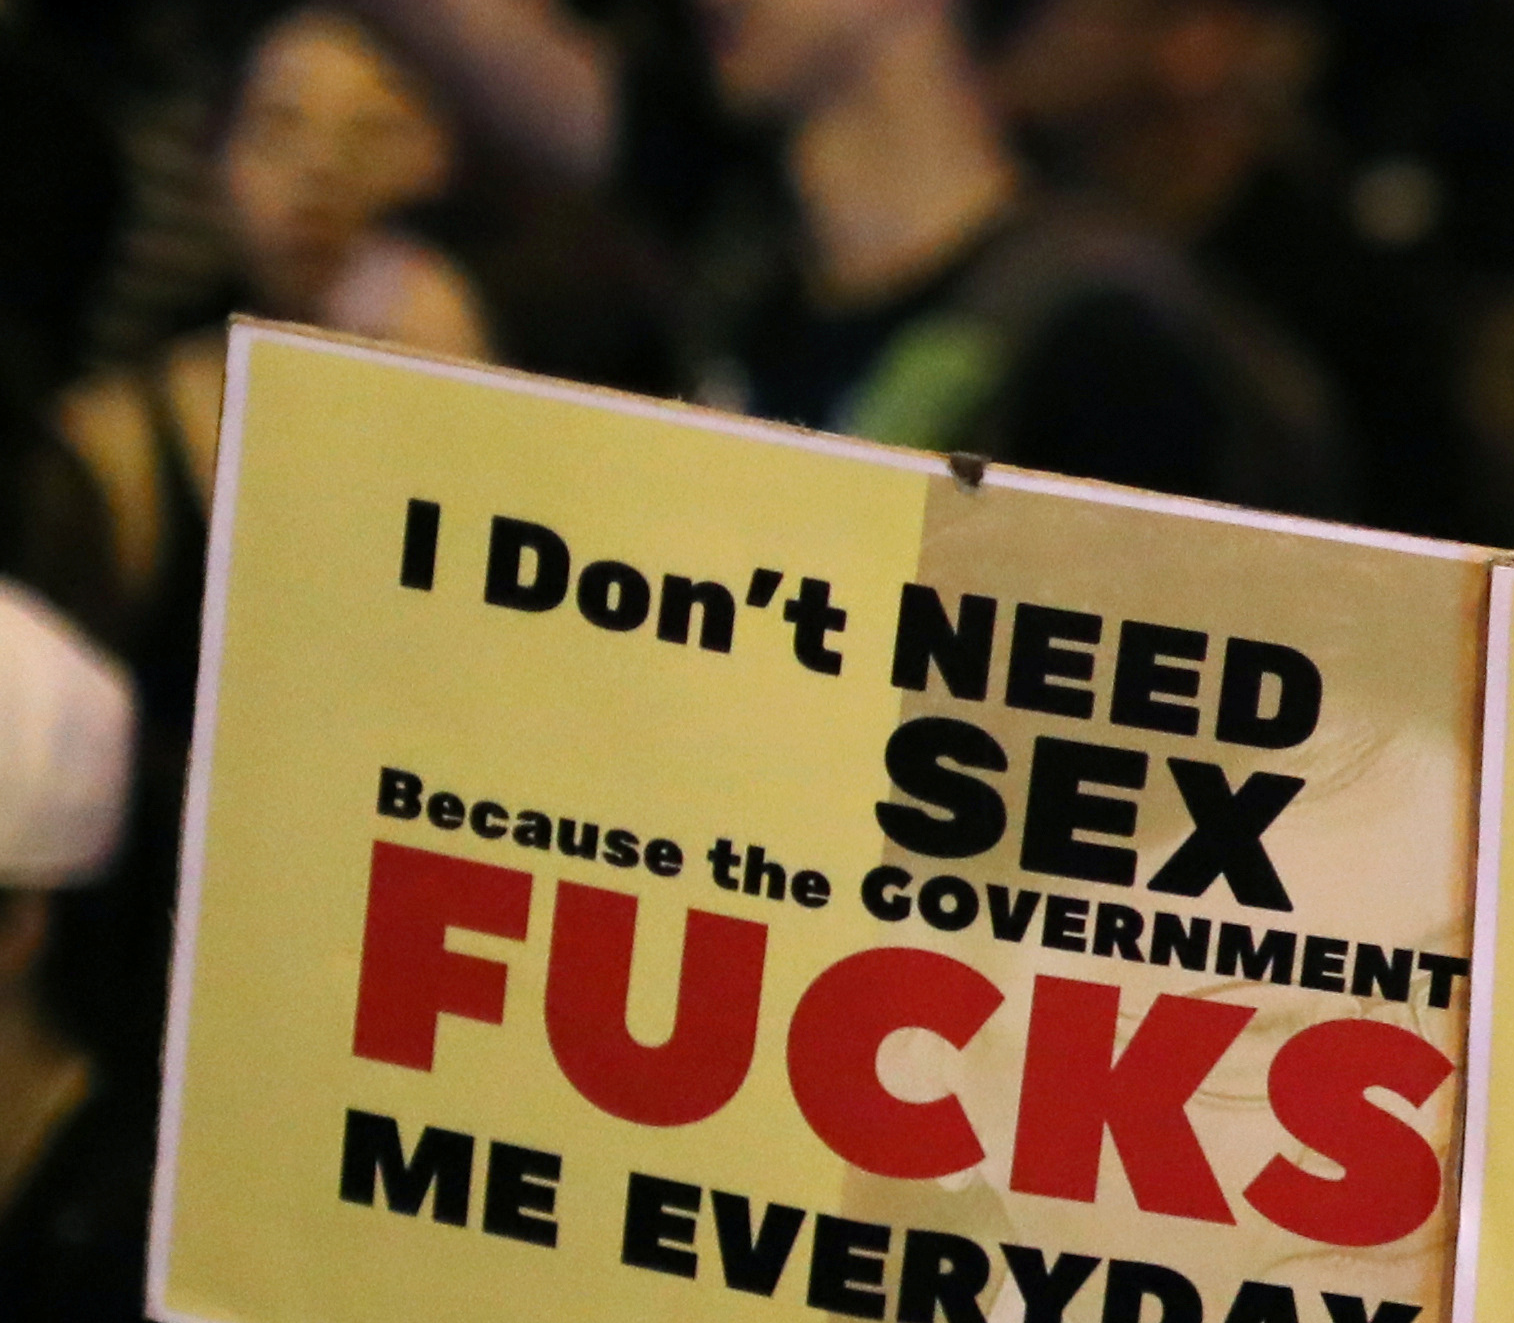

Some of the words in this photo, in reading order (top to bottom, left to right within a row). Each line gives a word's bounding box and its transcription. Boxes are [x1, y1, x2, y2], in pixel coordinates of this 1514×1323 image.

[401, 499, 440, 590] I
[485, 517, 846, 675] Don't
[892, 584, 1322, 749] NEED
[378, 768, 682, 876] Because
[708, 839, 830, 907] the
[862, 865, 1470, 1008] GOVERNMENT
[875, 717, 1304, 921] SEX
[355, 841, 1456, 1247] FUCKS
[340, 1109, 561, 1247] ME
